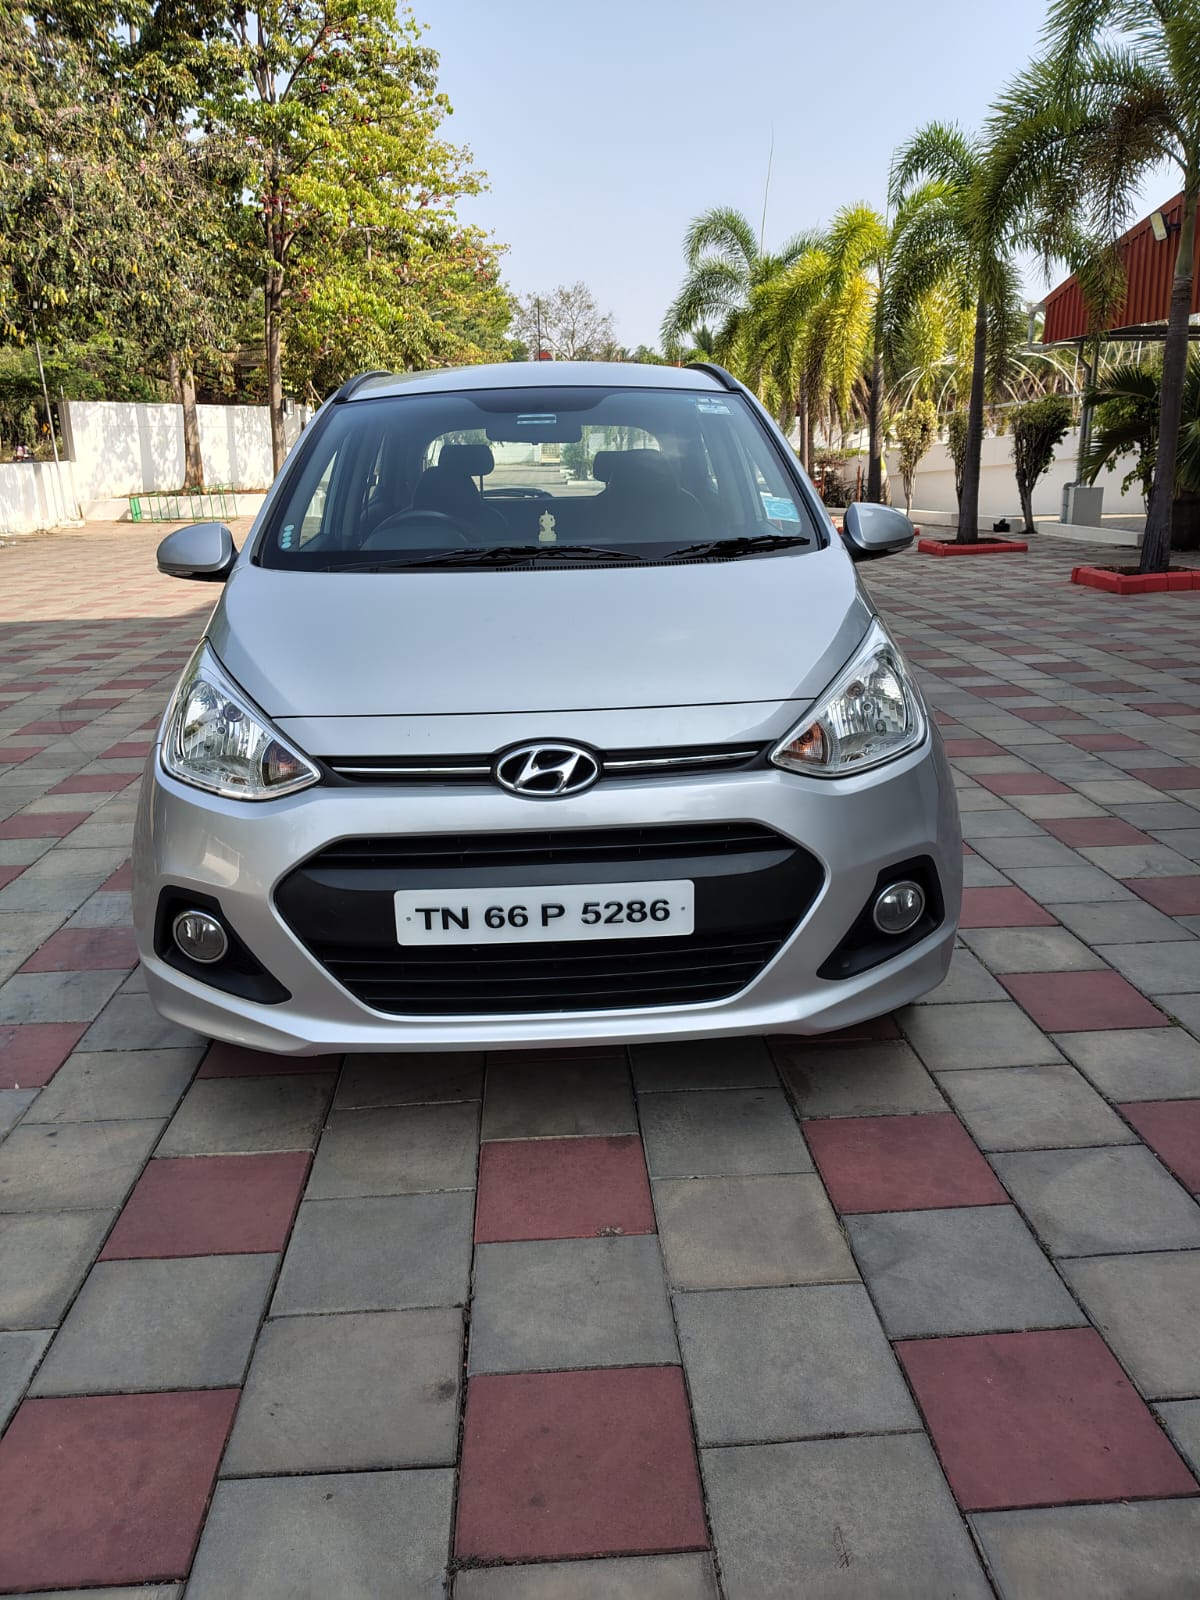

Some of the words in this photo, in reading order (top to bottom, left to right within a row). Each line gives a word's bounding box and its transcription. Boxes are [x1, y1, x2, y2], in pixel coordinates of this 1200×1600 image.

[415, 907, 469, 930] TN
[484, 905, 529, 929] 66
[541, 903, 566, 927] P
[581, 899, 670, 925] 5286
